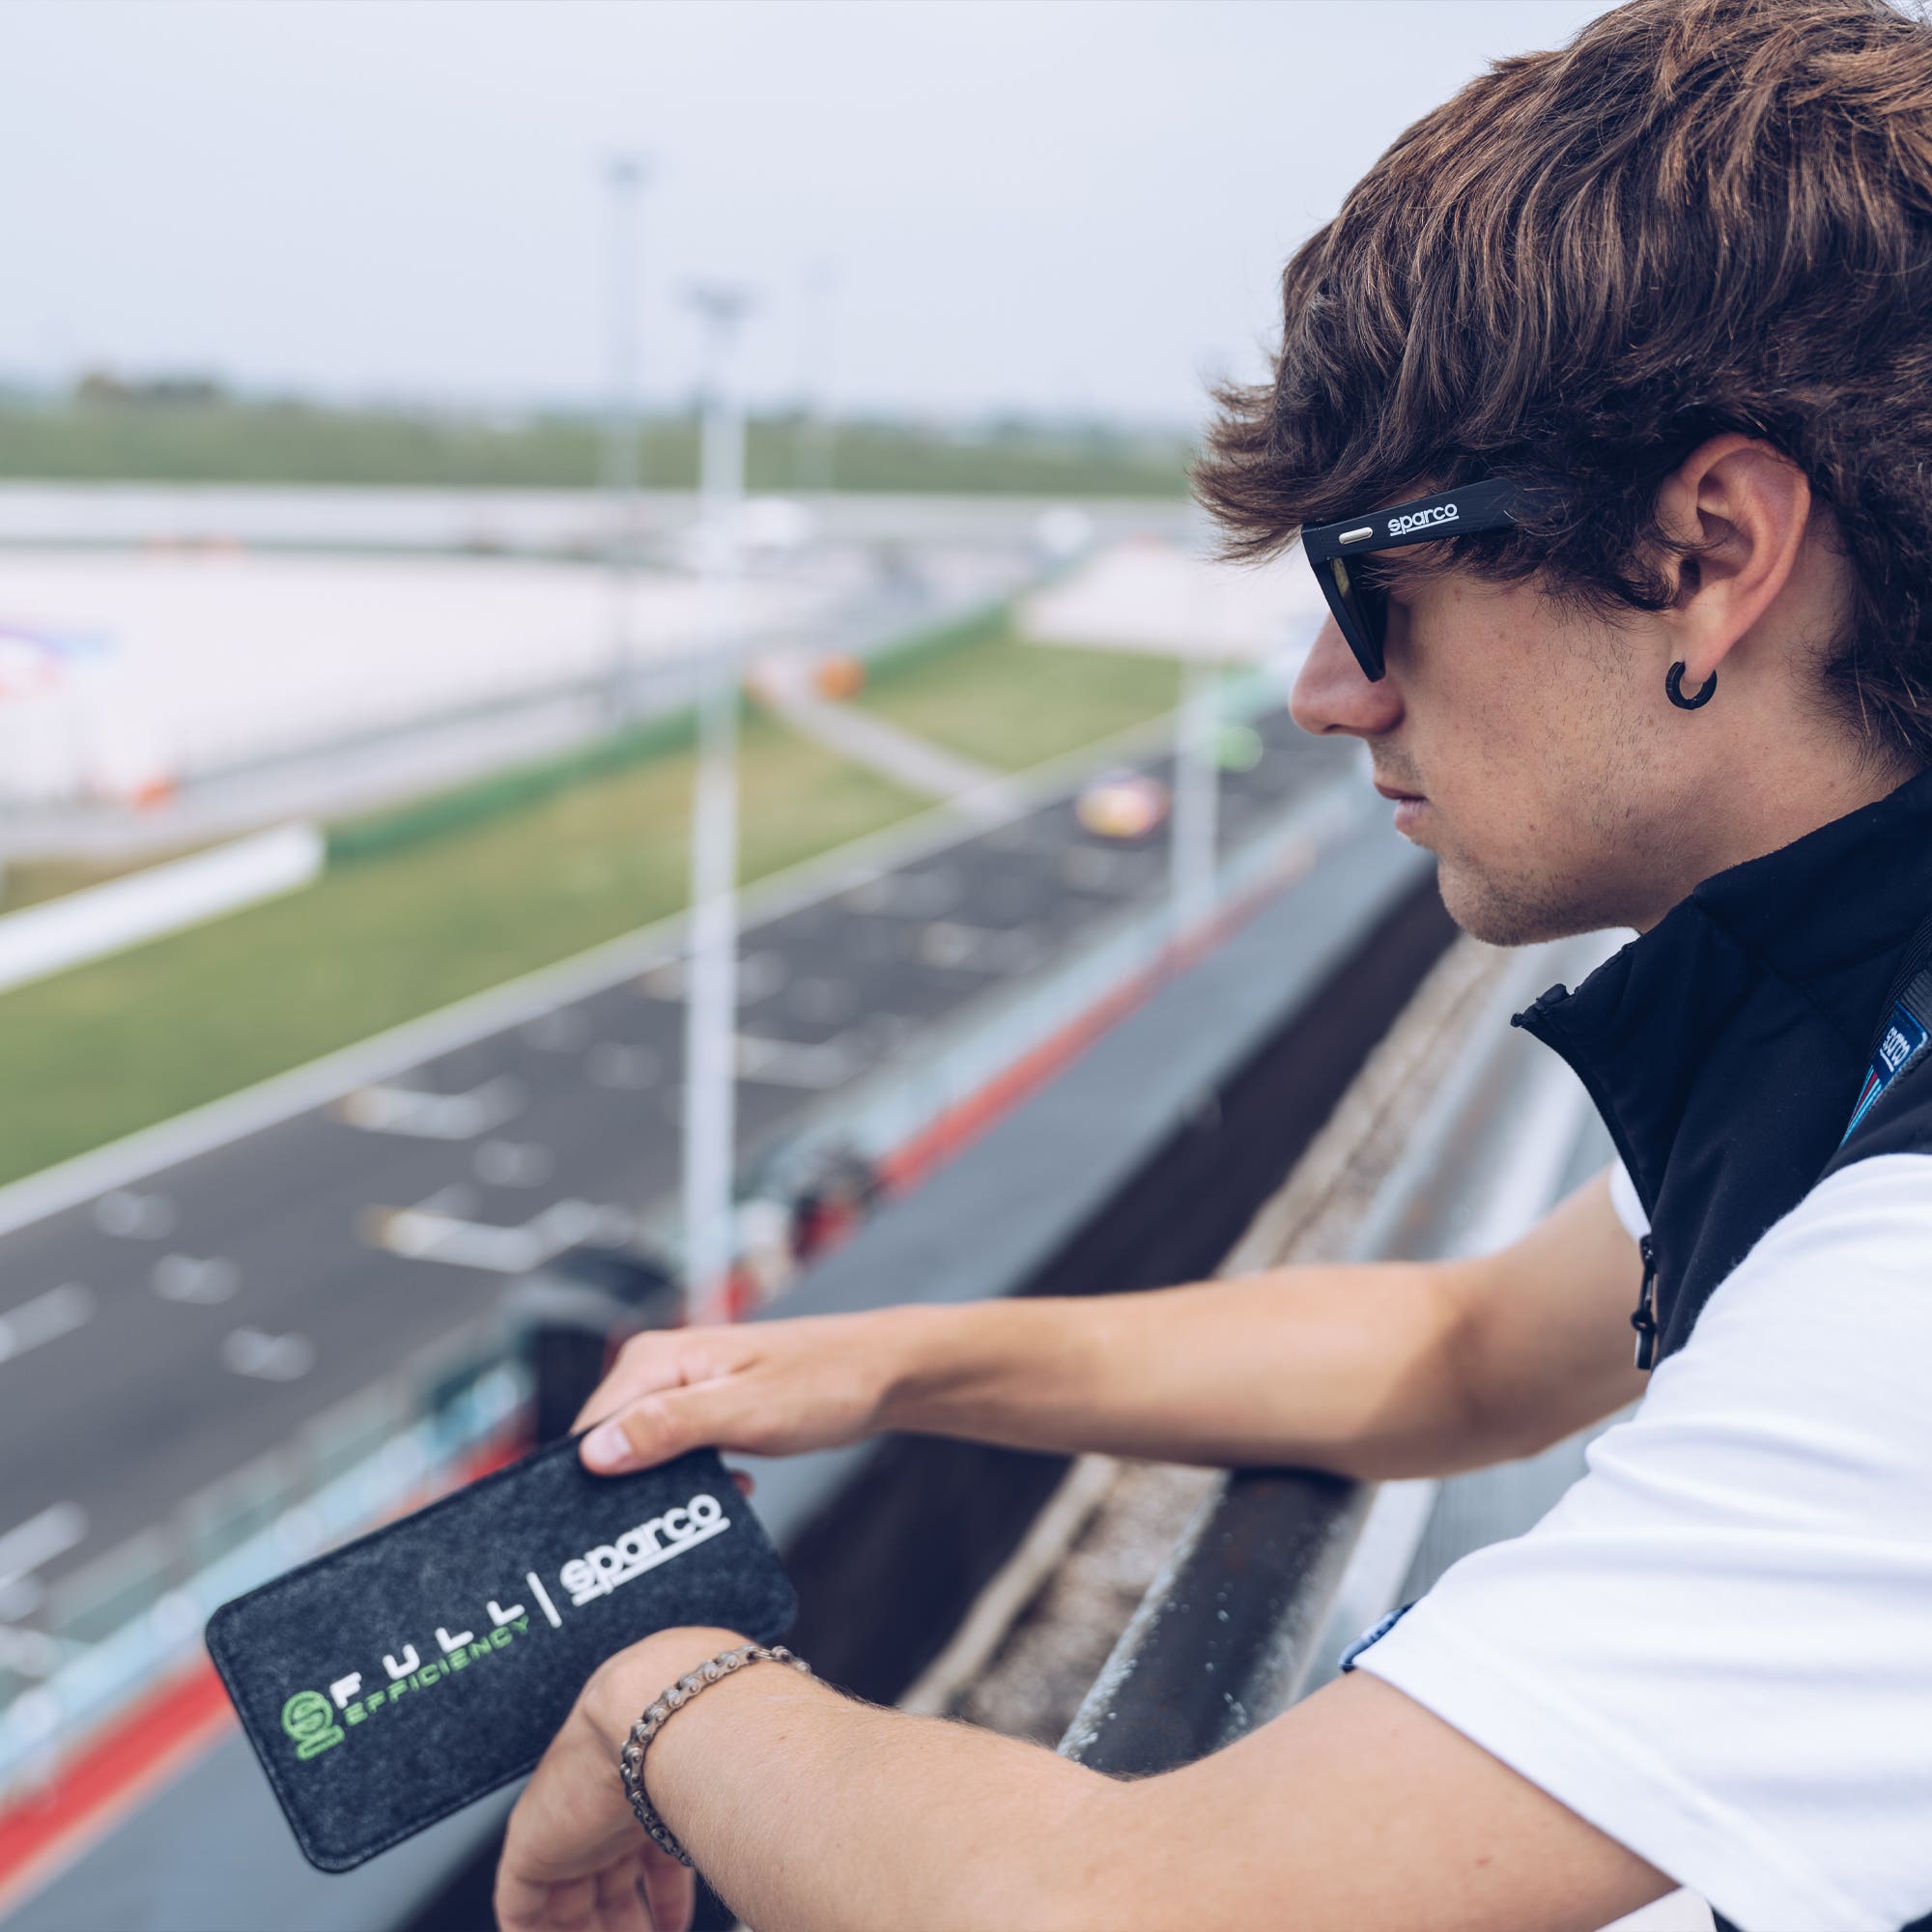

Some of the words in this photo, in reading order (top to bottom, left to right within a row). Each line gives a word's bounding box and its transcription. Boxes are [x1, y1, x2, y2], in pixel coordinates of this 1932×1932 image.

[1387, 503, 1459, 535] sparco
[560, 1493, 724, 1600] sparco
[329, 1600, 525, 1710] FULL
[343, 1614, 530, 1727] EFFICIENCY
